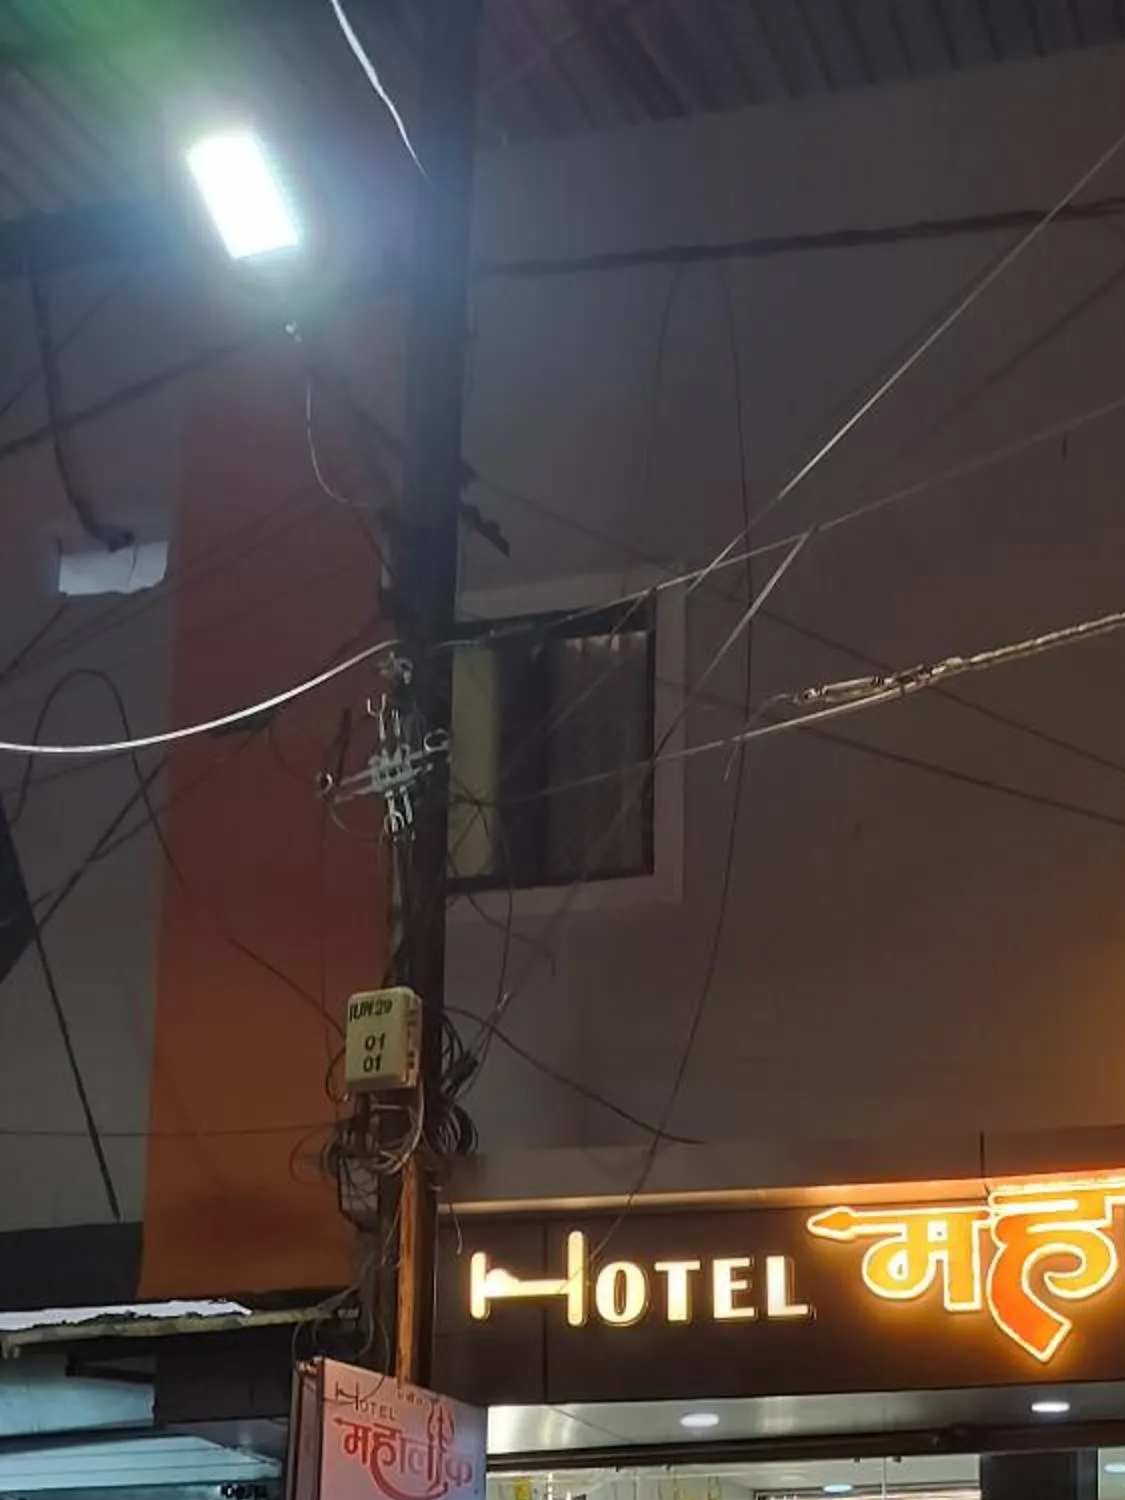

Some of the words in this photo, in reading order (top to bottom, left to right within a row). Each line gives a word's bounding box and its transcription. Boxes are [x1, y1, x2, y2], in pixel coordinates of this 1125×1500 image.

[364, 1034, 386, 1052] 01
[362, 1055, 382, 1073] 01
[469, 1230, 813, 1327] HOTEL
[335, 1382, 397, 1421] HOTEL
